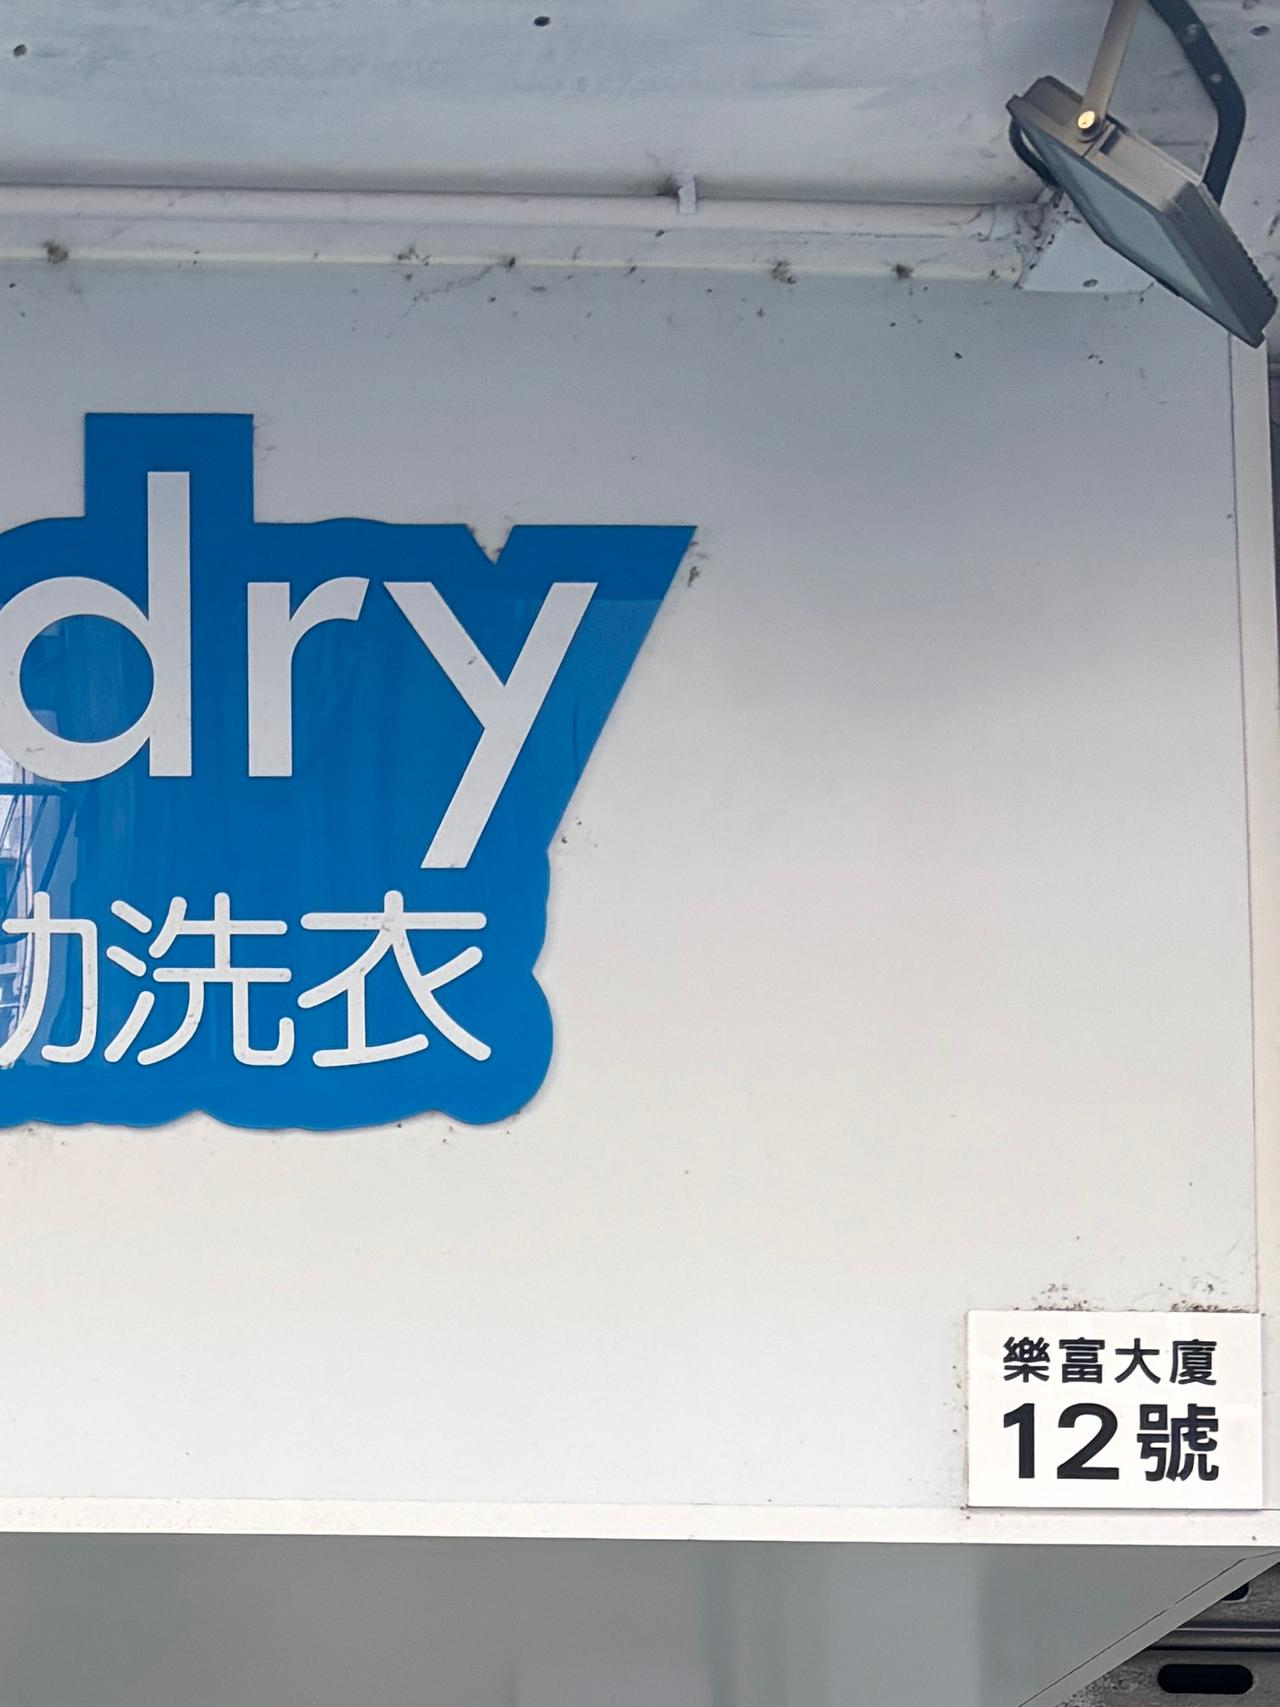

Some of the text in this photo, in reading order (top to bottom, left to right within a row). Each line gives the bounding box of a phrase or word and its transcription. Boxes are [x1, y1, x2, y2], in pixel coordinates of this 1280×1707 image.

[1002, 1333, 1221, 1390] 樂富大廈
[1002, 1403, 1221, 1486] 12號
